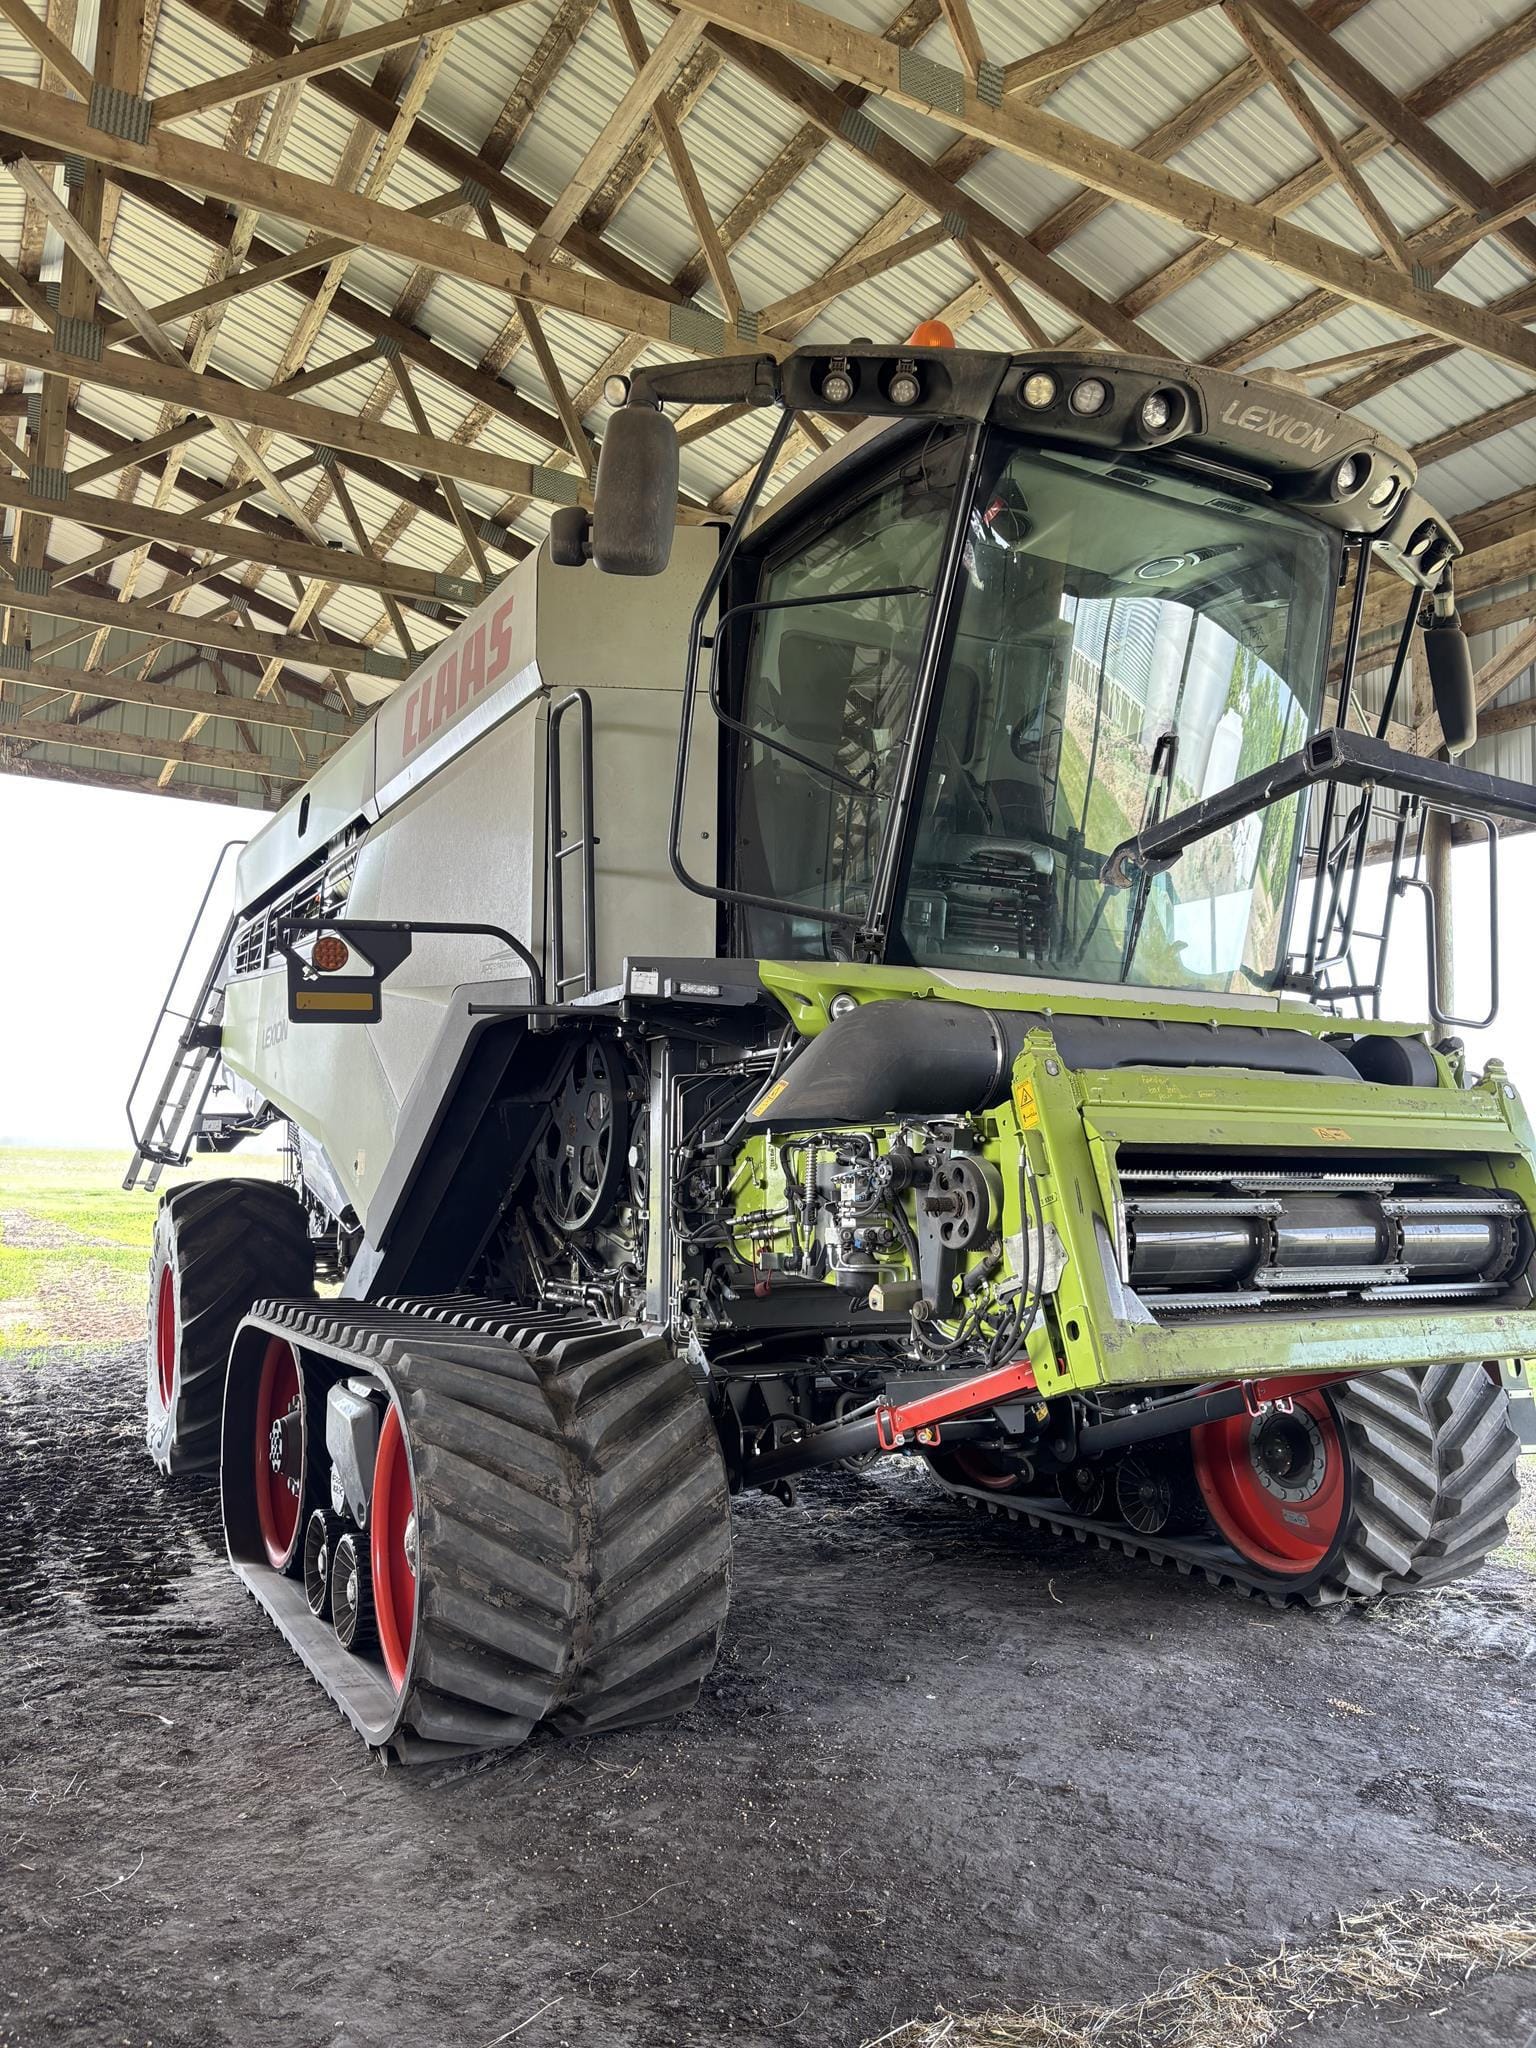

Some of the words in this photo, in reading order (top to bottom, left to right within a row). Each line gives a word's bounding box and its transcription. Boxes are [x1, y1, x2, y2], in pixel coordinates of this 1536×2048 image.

[1222, 400, 1335, 453] LEXION
[403, 595, 514, 758] CLAAS
[262, 1018, 288, 1049] LEXION
